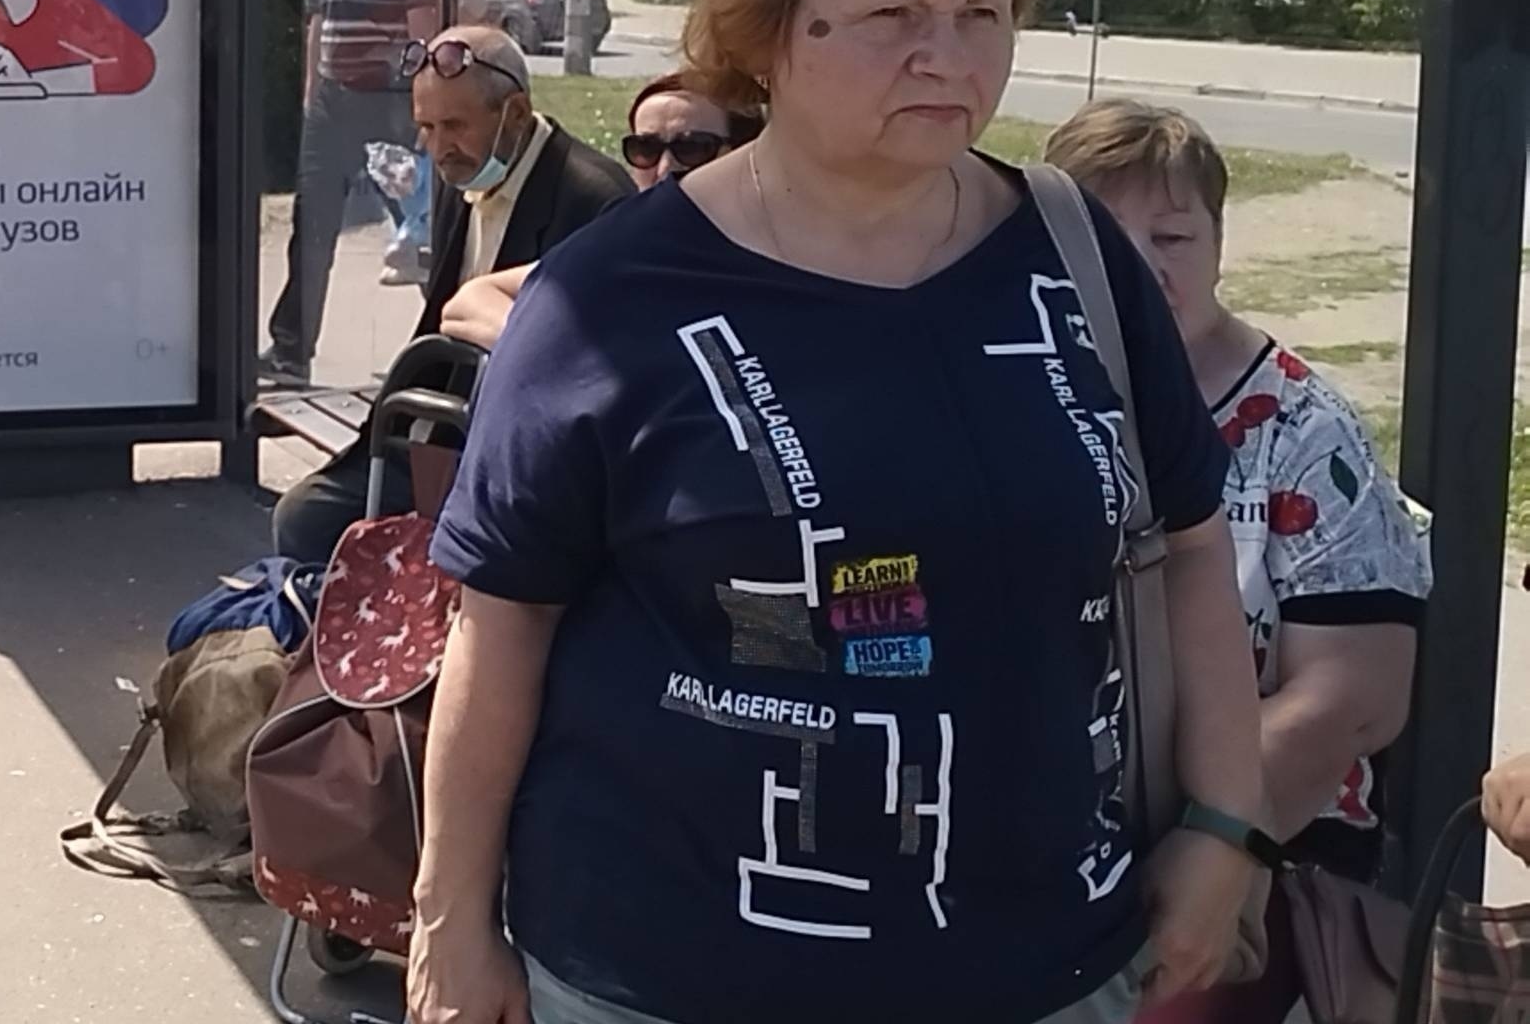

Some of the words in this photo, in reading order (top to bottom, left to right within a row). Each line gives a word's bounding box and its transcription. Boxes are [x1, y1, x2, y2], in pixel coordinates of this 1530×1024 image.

[16, 172, 146, 205] онлайн
[735, 356, 776, 407] KARL
[758, 403, 822, 509] LAGERFELD
[1043, 357, 1077, 407] KARL
[1067, 409, 1119, 526] LAGERFELD
[845, 596, 913, 626] LIVE
[853, 640, 909, 662] HOPE
[708, 684, 836, 730] LAGERFELD
